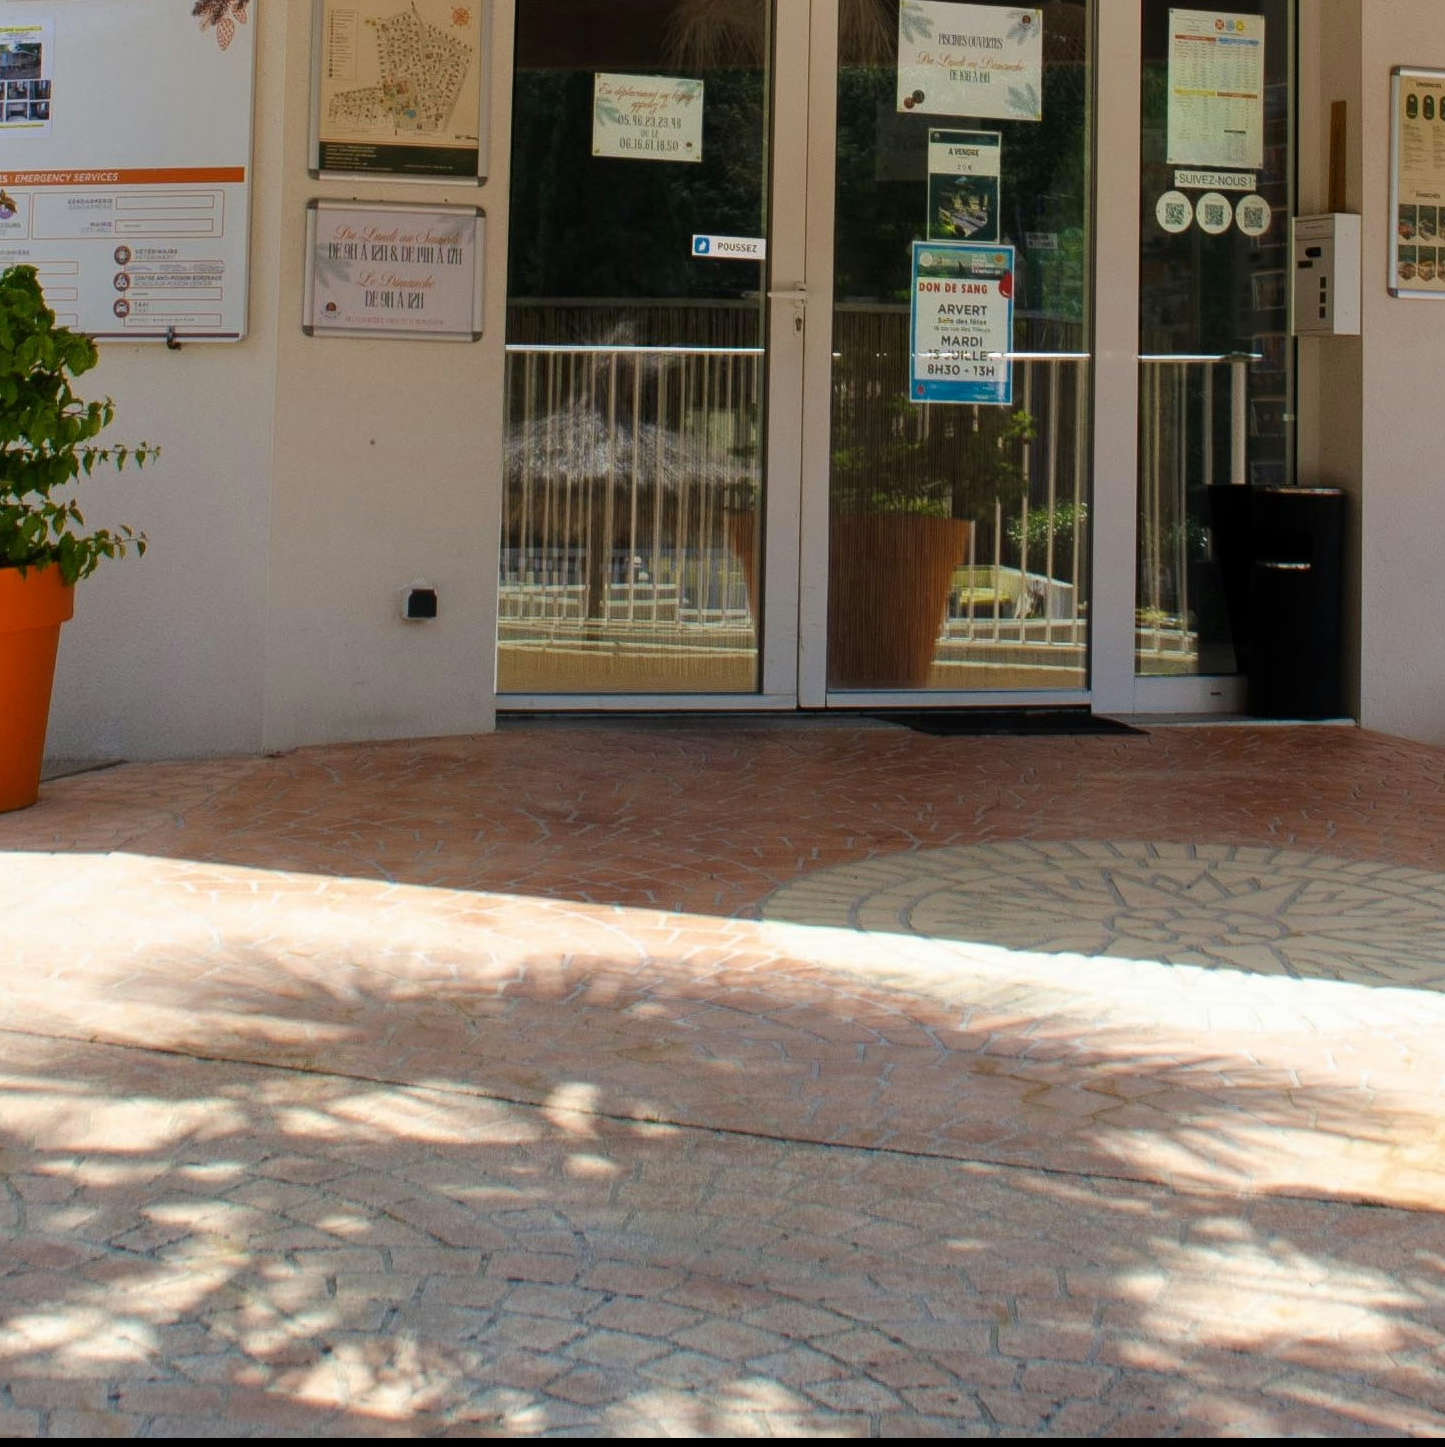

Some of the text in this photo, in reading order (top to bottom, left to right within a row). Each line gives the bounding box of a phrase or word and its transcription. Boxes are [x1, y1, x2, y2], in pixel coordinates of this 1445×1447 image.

[968, 35, 1003, 50] OUVERTES
[955, 148, 980, 157] VENDRE
[14, 172, 71, 184] EMERGENCY
[72, 172, 119, 182] SERVICES
[1179, 174, 1248, 186] SUIVEZ-NOUS
[334, 224, 356, 240] Du
[360, 226, 399, 244] Lundi
[328, 242, 342, 260] DE
[344, 242, 357, 260] 9H
[371, 243, 388, 262] 12H
[390, 244, 398, 262] &
[401, 244, 415, 263] DE
[718, 242, 758, 253] POUSSEZ
[356, 272, 376, 288] Le
[919, 282, 988, 294] DON DE SANG
[365, 290, 378, 308] DE
[381, 291, 394, 309] 9H
[408, 292, 424, 311] 12H
[938, 304, 987, 315] ARVERT
[941, 336, 983, 347] MARDI
[927, 364, 960, 375] 8H30
[973, 365, 995, 376] 13H
